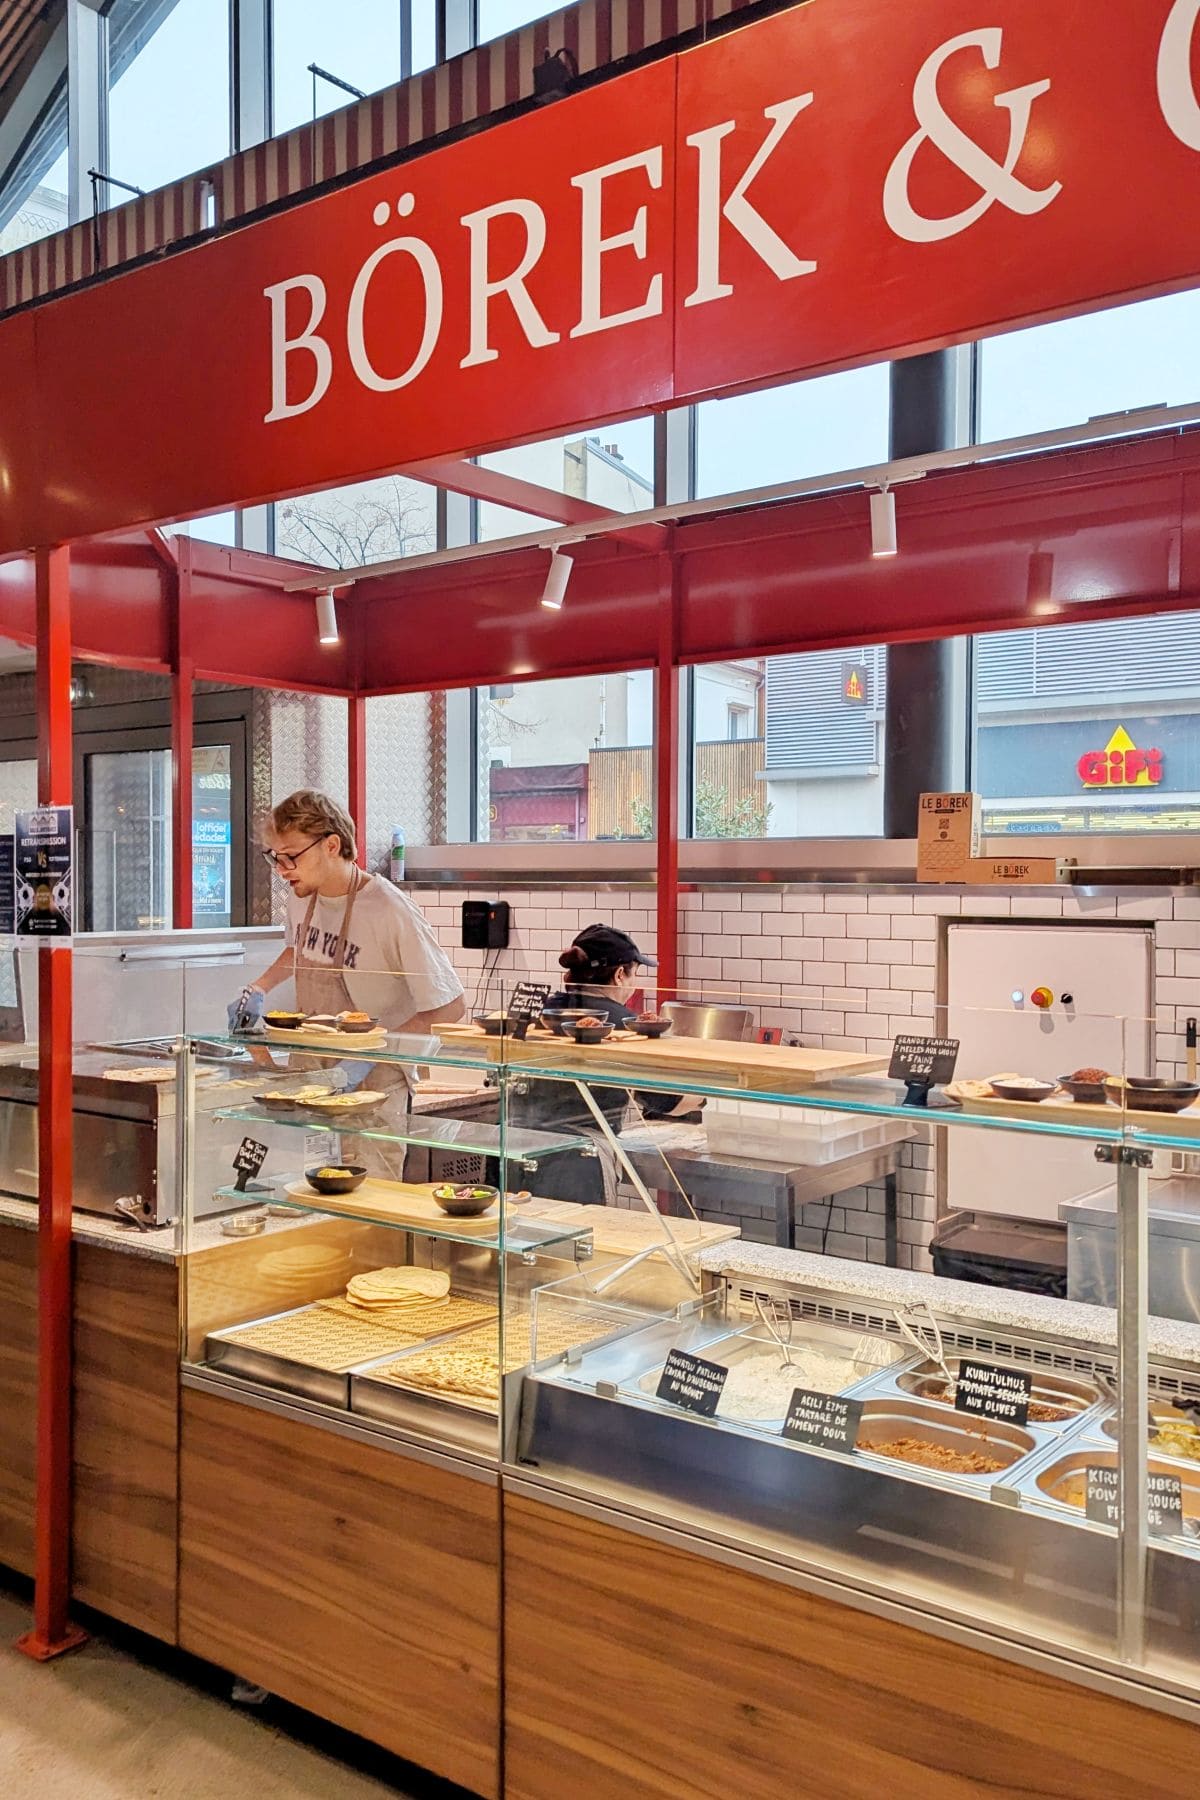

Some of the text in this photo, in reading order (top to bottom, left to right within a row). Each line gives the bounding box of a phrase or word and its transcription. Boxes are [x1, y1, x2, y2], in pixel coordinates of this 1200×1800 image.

[263, 91, 817, 424] BÖREK
[883, 27, 1063, 243] &
[1077, 747, 1163, 785] GiFi
[922, 798, 932, 809] LE
[993, 865, 1001, 874] LE
[926, 1038, 959, 1048] PLANCHE
[914, 1055, 934, 1065] PAINS
[670, 1380, 681, 1392] AU
[959, 1379, 995, 1397] TOMATE
[966, 1395, 1017, 1417] AUX OLIVES
[795, 1407, 848, 1426] TARTARE DE
[786, 1417, 847, 1441] PIMENT DOUX
[1087, 1486, 1117, 1501] POIV
